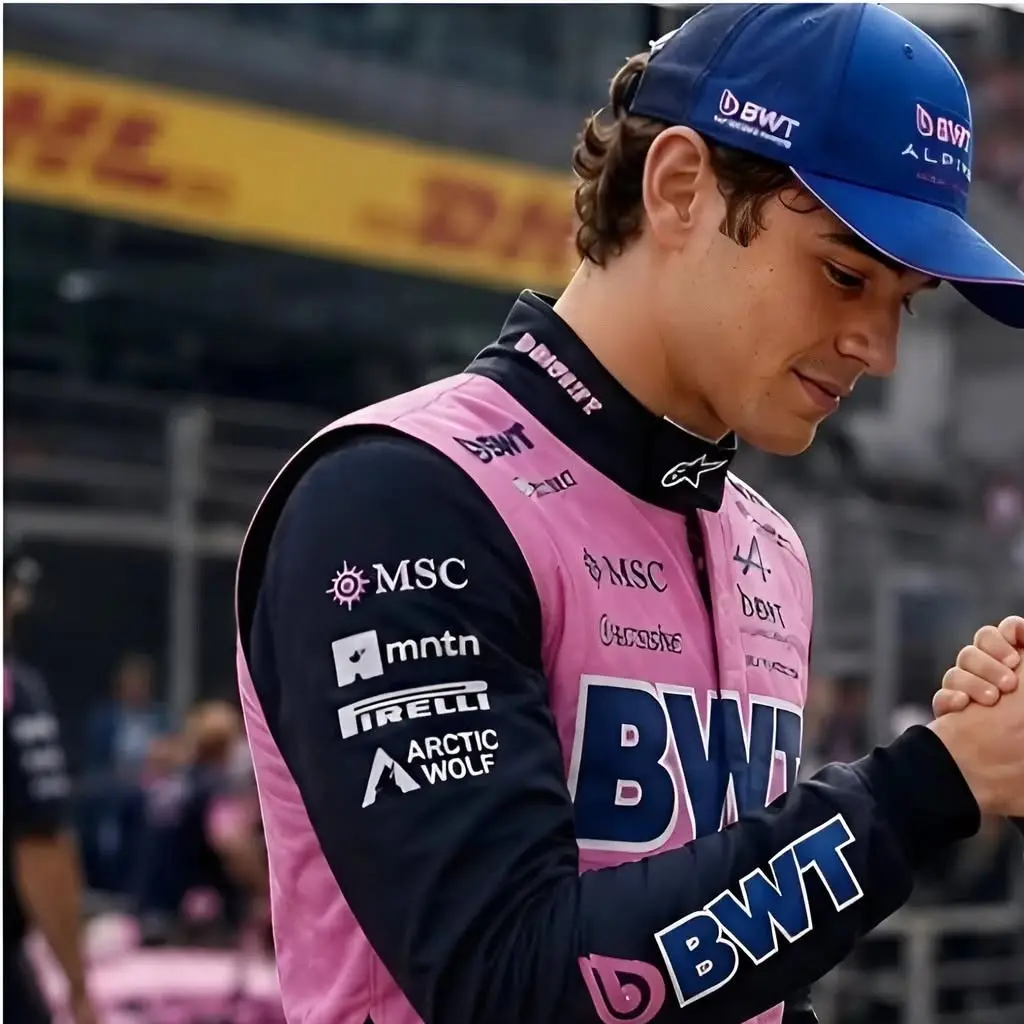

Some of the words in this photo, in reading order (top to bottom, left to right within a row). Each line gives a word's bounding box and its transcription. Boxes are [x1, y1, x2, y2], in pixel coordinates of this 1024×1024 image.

[740, 101, 801, 140] BWT
[372, 557, 469, 595] MSC
[602, 556, 668, 592] MSC
[386, 630, 481, 665] mntn
[337, 680, 490, 739] PIRELLI
[407, 729, 499, 763] ARCTIC
[568, 674, 803, 849] BWT
[421, 753, 495, 784] WOLF
[654, 813, 864, 1008] BWT
